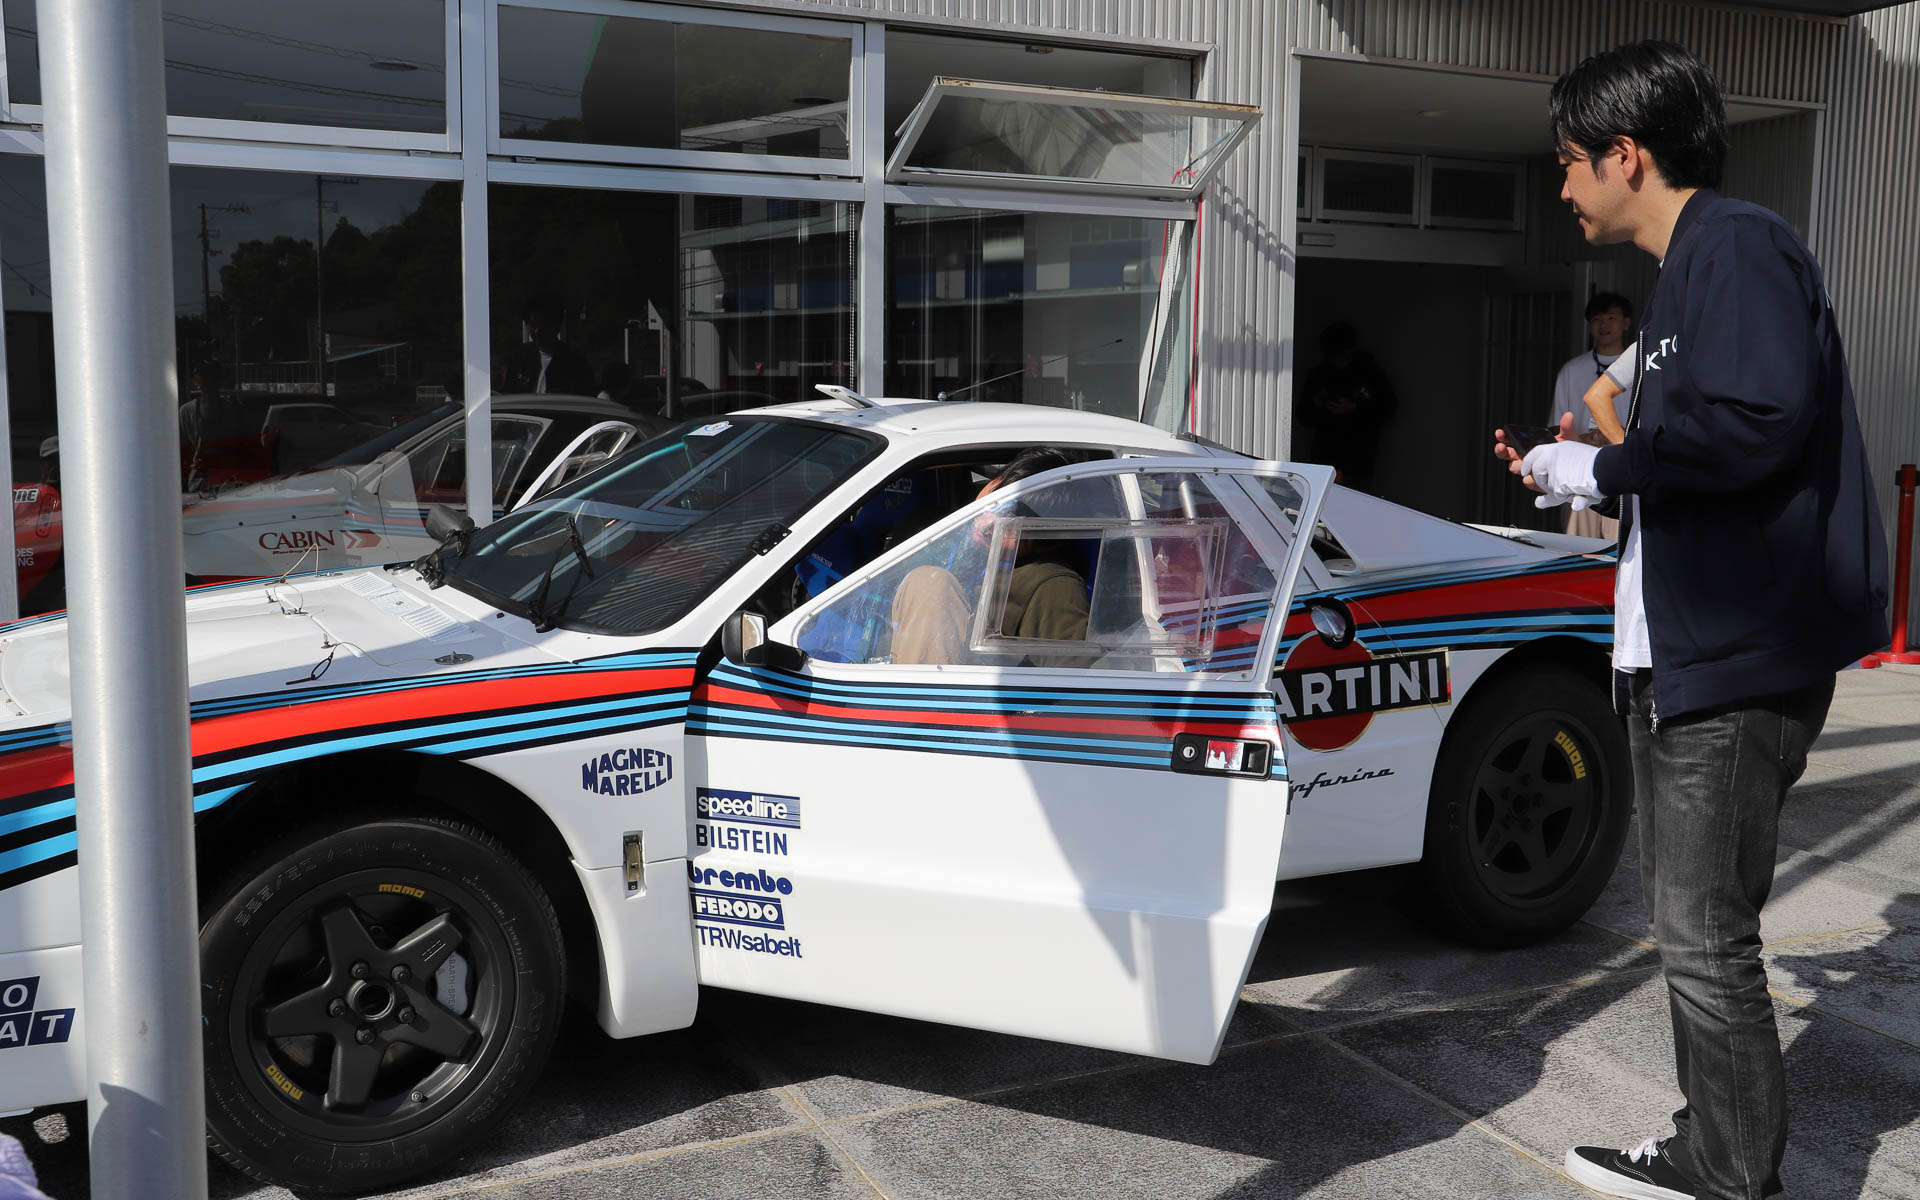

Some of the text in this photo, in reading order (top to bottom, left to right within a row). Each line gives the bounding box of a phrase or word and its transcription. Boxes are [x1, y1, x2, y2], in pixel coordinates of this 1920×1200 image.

[258, 529, 336, 550] CABIN
[1272, 657, 1439, 718] ARTINI
[582, 747, 673, 779] MAGNETI
[582, 769, 673, 796] MARELLI
[697, 794, 789, 820] speedline
[695, 823, 788, 856] BILSTEIN
[686, 860, 794, 896] brembo
[695, 895, 780, 923] FERODO
